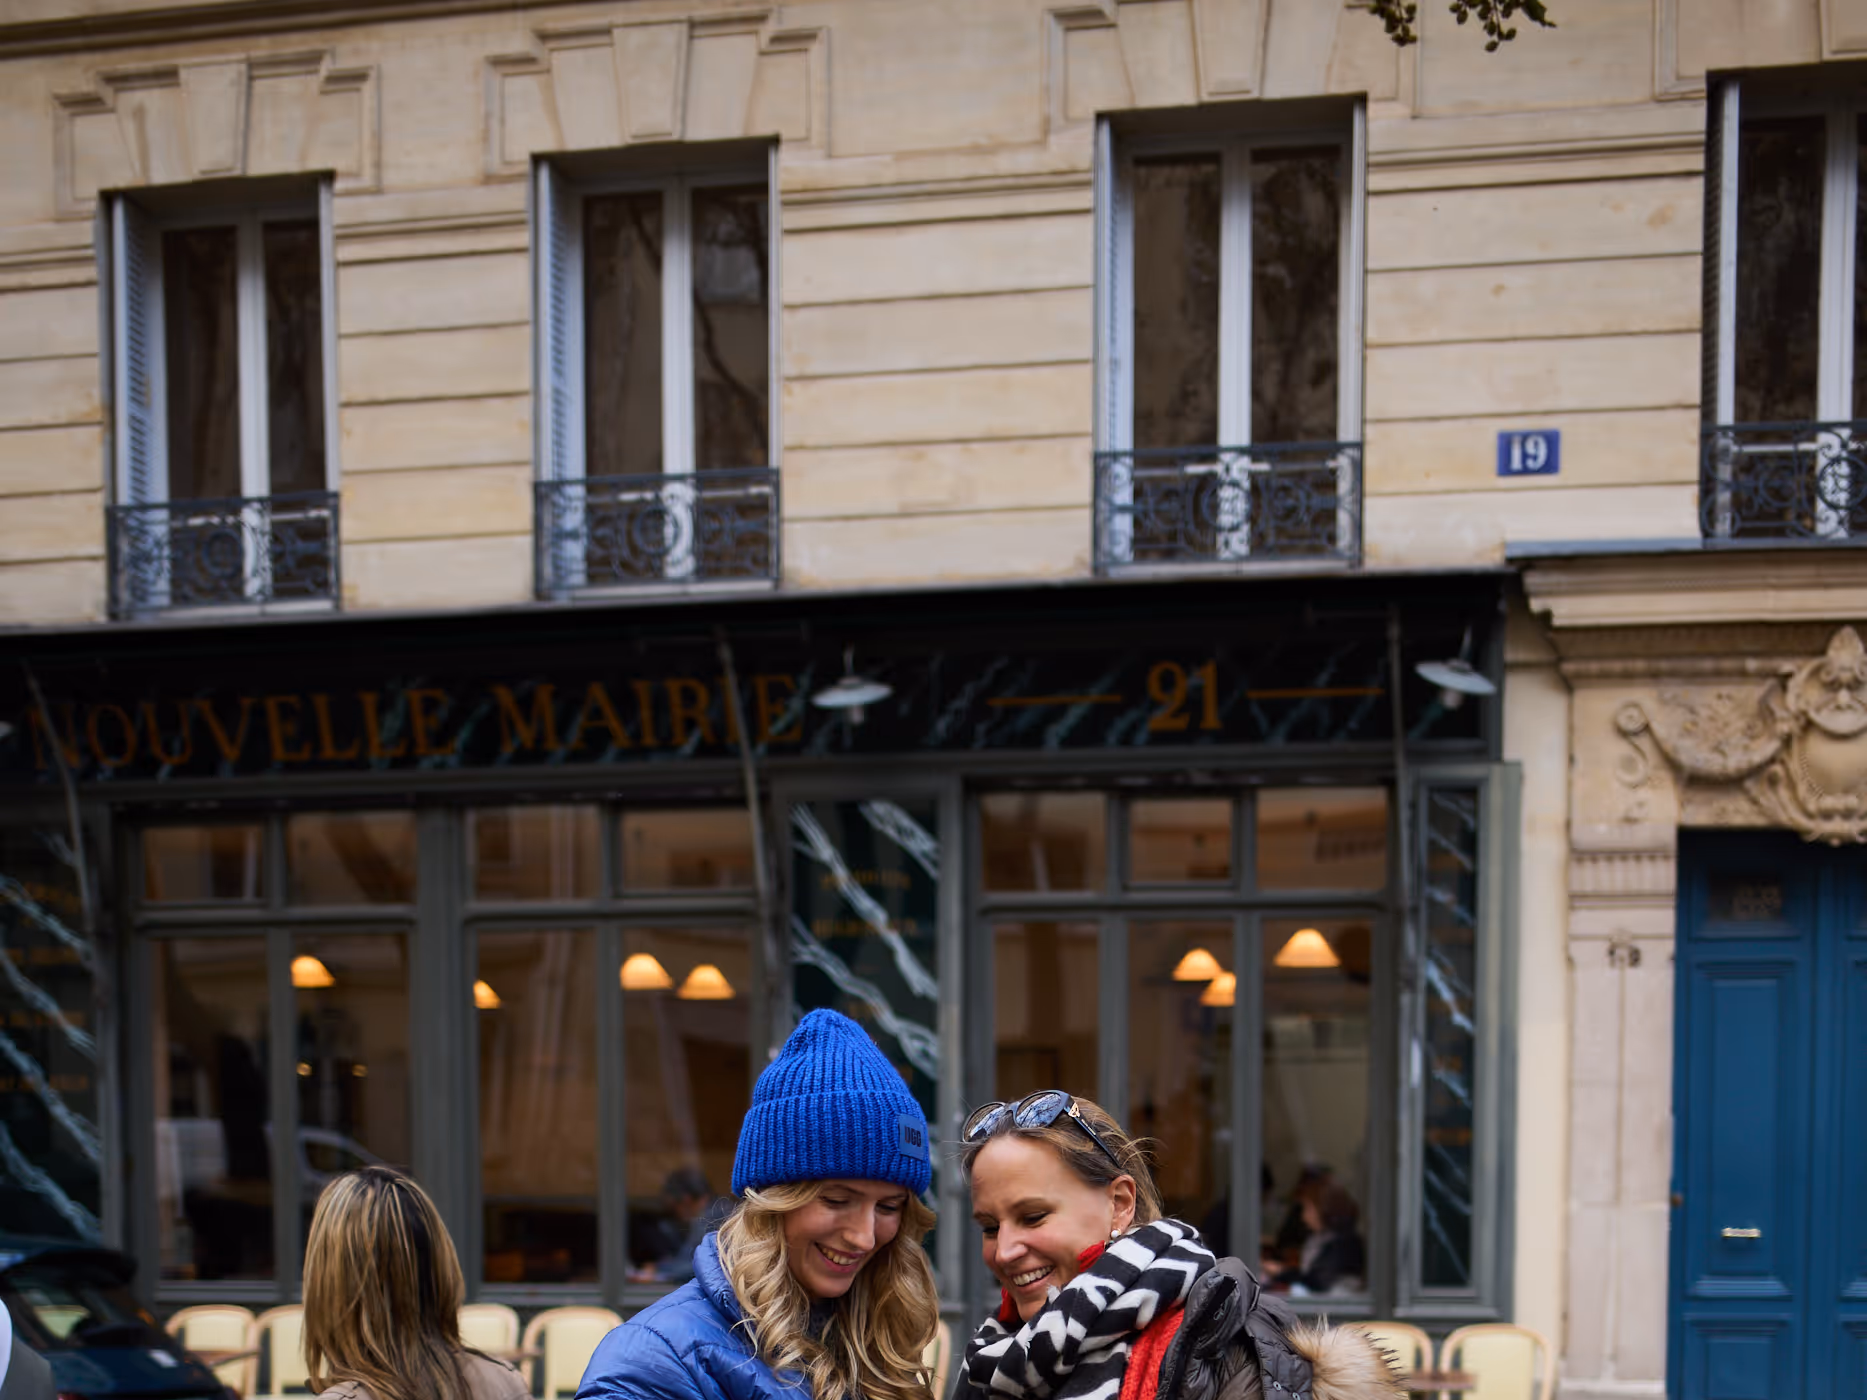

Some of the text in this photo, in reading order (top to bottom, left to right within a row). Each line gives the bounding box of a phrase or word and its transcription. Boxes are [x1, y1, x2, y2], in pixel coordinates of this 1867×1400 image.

[1509, 435, 1547, 471] 19
[28, 674, 805, 768] NOUVELLE MAIRIE
[1147, 660, 1223, 731] 21
[904, 1125, 922, 1148] UGG
